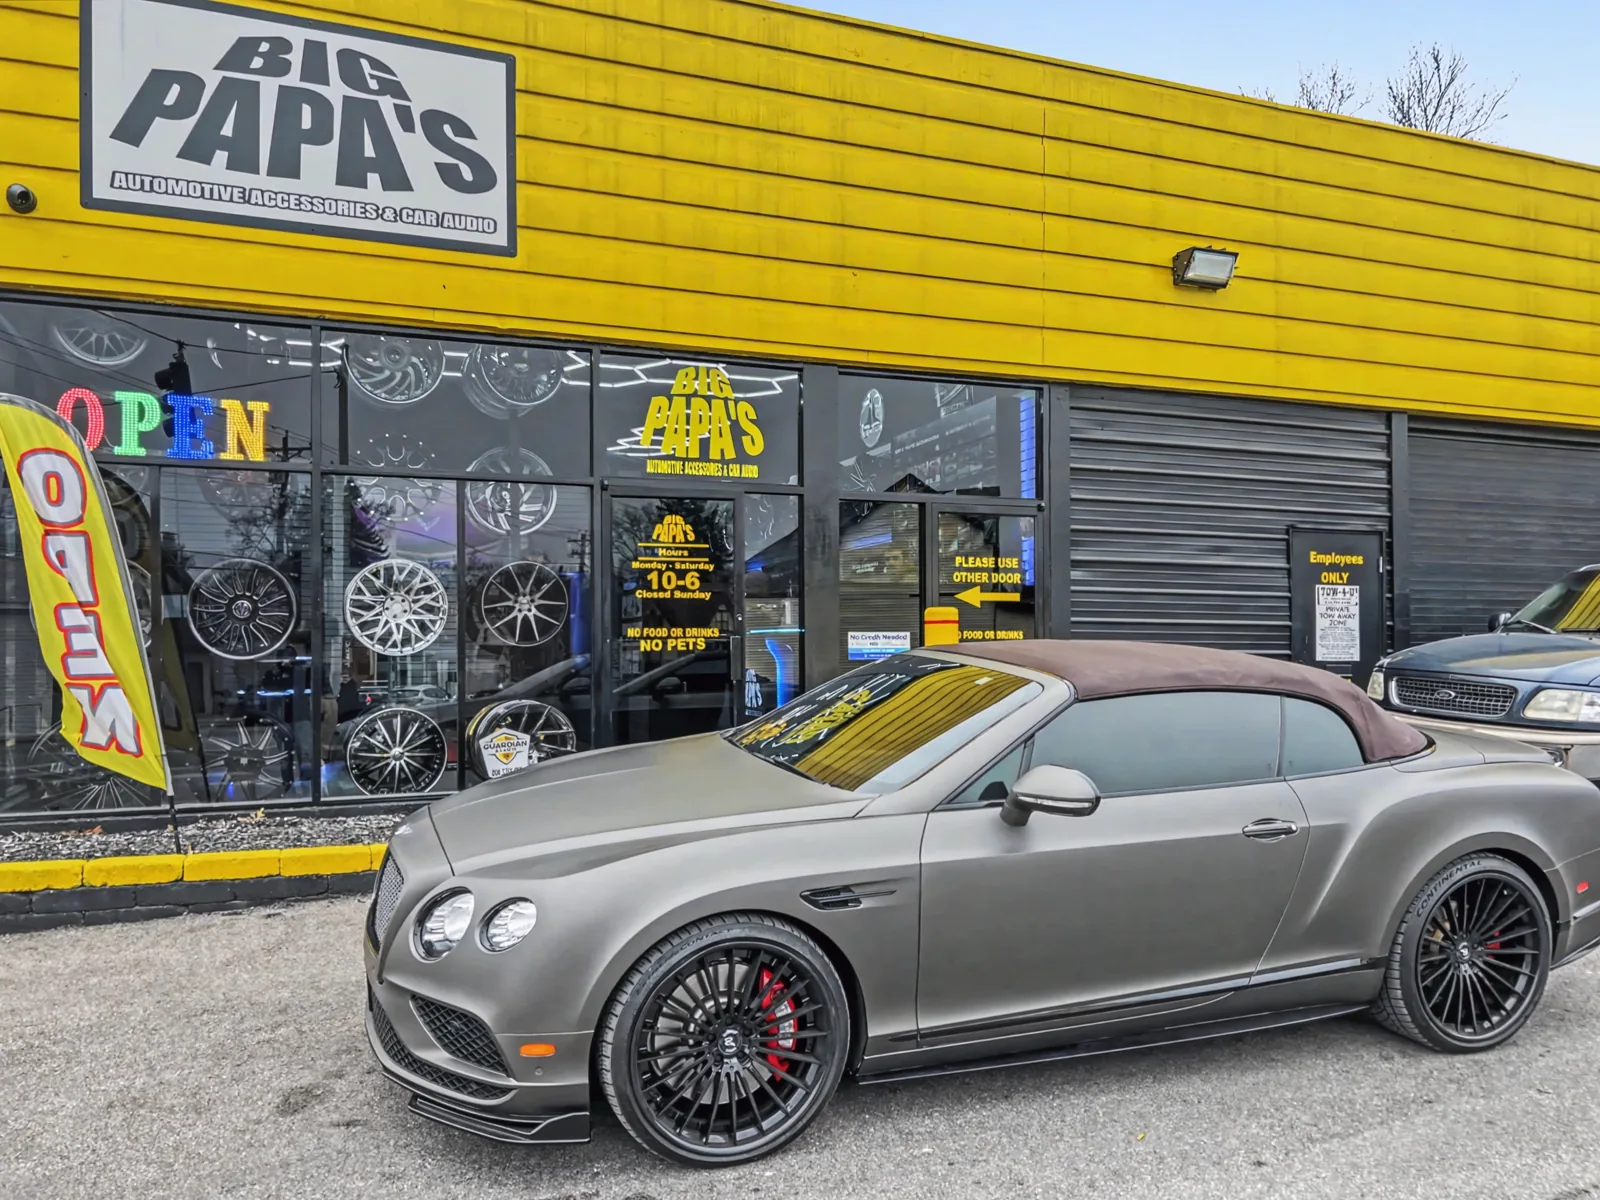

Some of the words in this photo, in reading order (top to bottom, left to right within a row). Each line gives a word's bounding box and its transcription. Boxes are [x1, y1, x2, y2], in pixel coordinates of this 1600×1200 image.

[213, 36, 412, 102] BIG
[109, 68, 498, 194] PAPA'S
[110, 170, 247, 204] AUTOMOTIVE
[247, 188, 381, 221] ACCESSORIES
[380, 206, 399, 223] &
[399, 207, 440, 227] CAR
[440, 211, 497, 234] AUDIO
[670, 366, 735, 399] BIG
[56, 387, 271, 462] OPEN
[639, 396, 765, 460] PAPA'S
[663, 514, 685, 525] BIG
[652, 523, 695, 543] PAPA'S
[658, 548, 688, 557] Hours
[1309, 550, 1364, 567] Employees
[631, 561, 667, 571] Monday
[674, 562, 714, 572] Saturday
[955, 556, 995, 568] PLEASE
[997, 557, 1019, 568] USE
[646, 570, 701, 590] 10-6
[953, 571, 989, 583] OTHER
[991, 572, 1021, 584] DOOR
[1320, 572, 1350, 584] ONLY
[635, 590, 671, 599] Closed
[673, 590, 712, 601] Sunday
[627, 628, 641, 638] NO
[643, 628, 668, 638] FOOD
[670, 628, 684, 638] OR
[685, 628, 720, 638] DRINKS
[963, 630, 983, 640] FOOD
[984, 630, 995, 640] OR
[996, 630, 1024, 640] DRINKS
[640, 639, 663, 652] NO
[667, 637, 706, 652] PETS
[483, 740, 528, 751] GUARDIAN
[1416, 860, 1483, 919] CONTINENTAL
